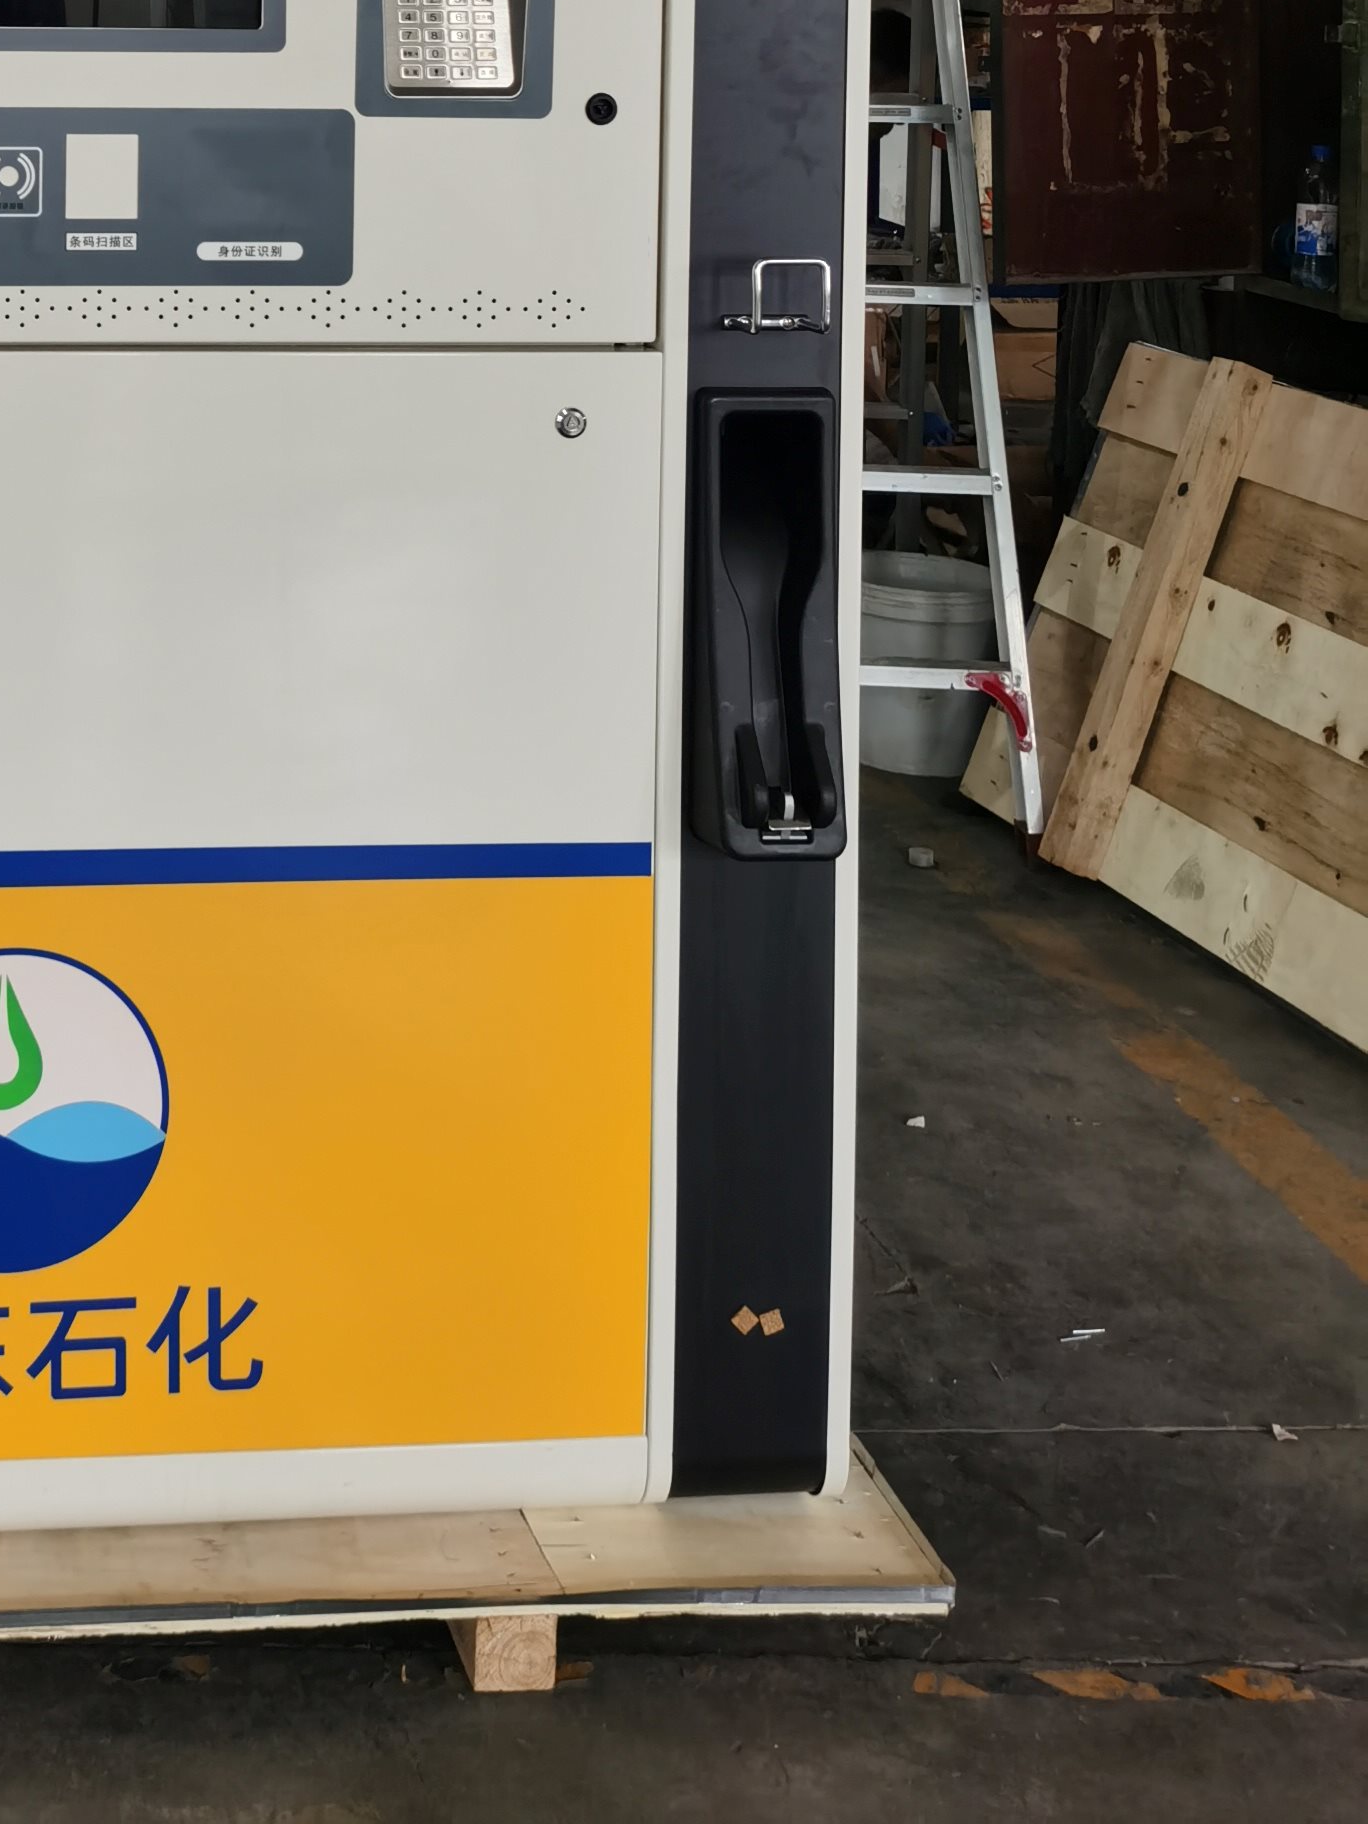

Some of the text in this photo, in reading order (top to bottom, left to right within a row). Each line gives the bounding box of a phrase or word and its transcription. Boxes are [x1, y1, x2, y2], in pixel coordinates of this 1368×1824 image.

[69, 236, 134, 248] 条码扫描区
[218, 245, 283, 258] 身份证识别
